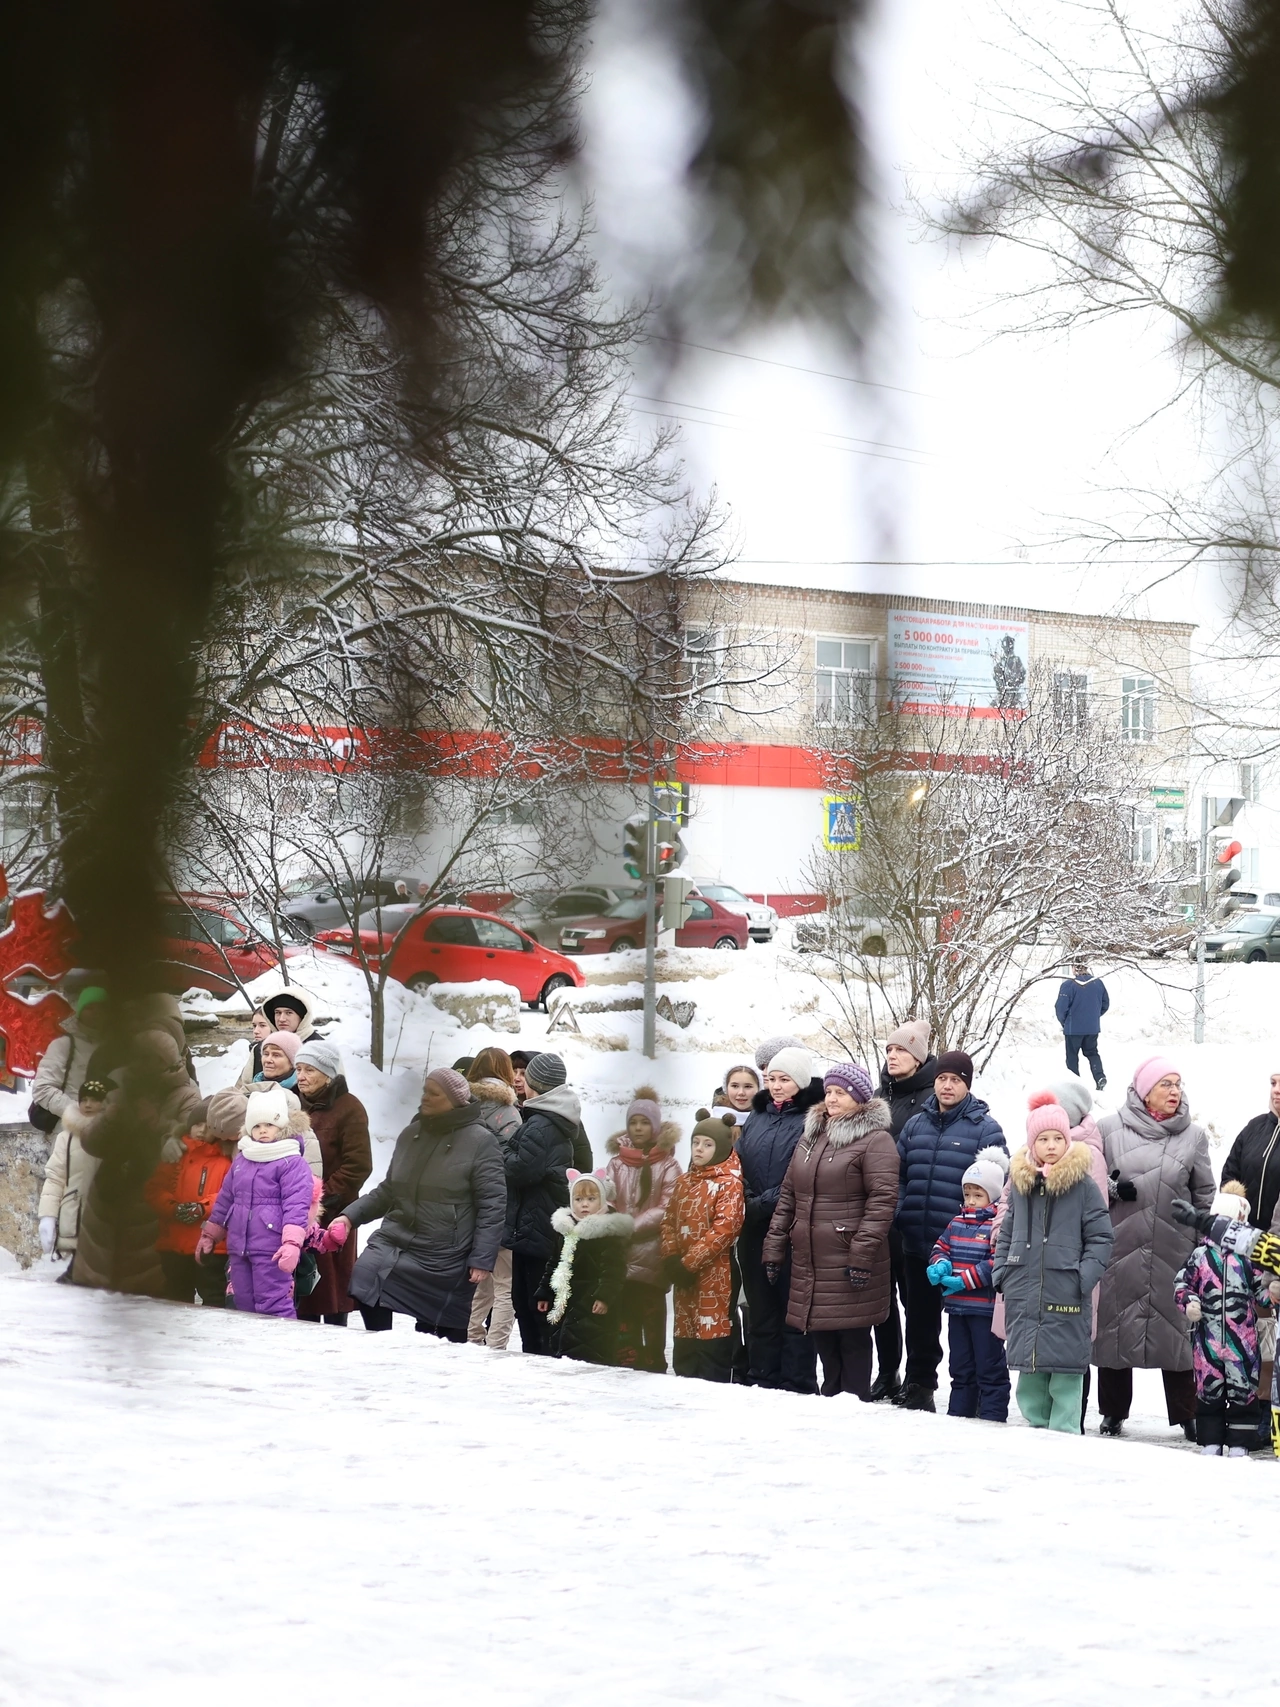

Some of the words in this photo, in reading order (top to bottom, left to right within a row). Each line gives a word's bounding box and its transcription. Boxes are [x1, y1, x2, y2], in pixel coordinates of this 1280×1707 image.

[904, 630, 910, 640] 5
[913, 631, 932, 642] 000
[934, 633, 953, 644] 000
[956, 638, 979, 647] РУБЛЕЙ
[894, 642, 918, 650] ВЫПЛАТЫ
[900, 662, 910, 670] 500
